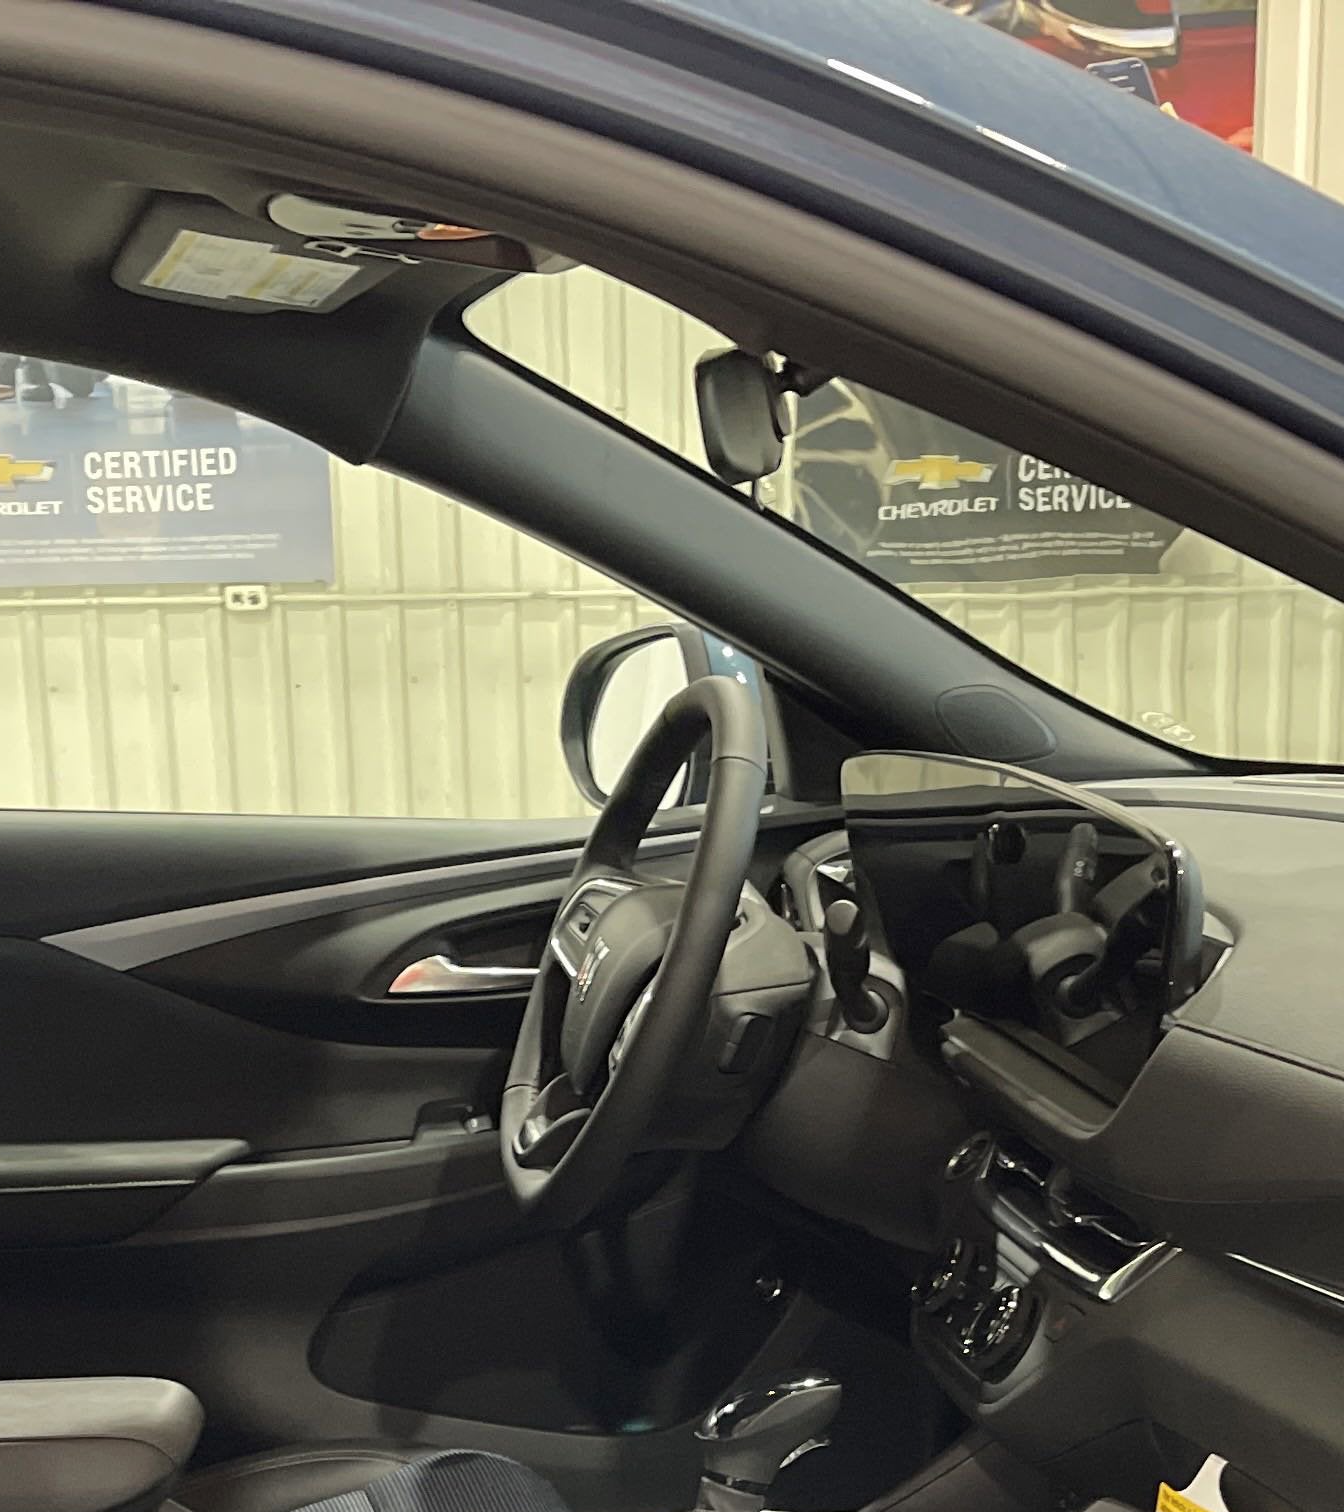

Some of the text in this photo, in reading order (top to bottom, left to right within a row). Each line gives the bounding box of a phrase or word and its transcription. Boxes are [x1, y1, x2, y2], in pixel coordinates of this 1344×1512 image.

[83, 447, 238, 480] CERTIFIED
[86, 482, 215, 515] SERVICE
[878, 496, 1000, 521] CHEVROLET
